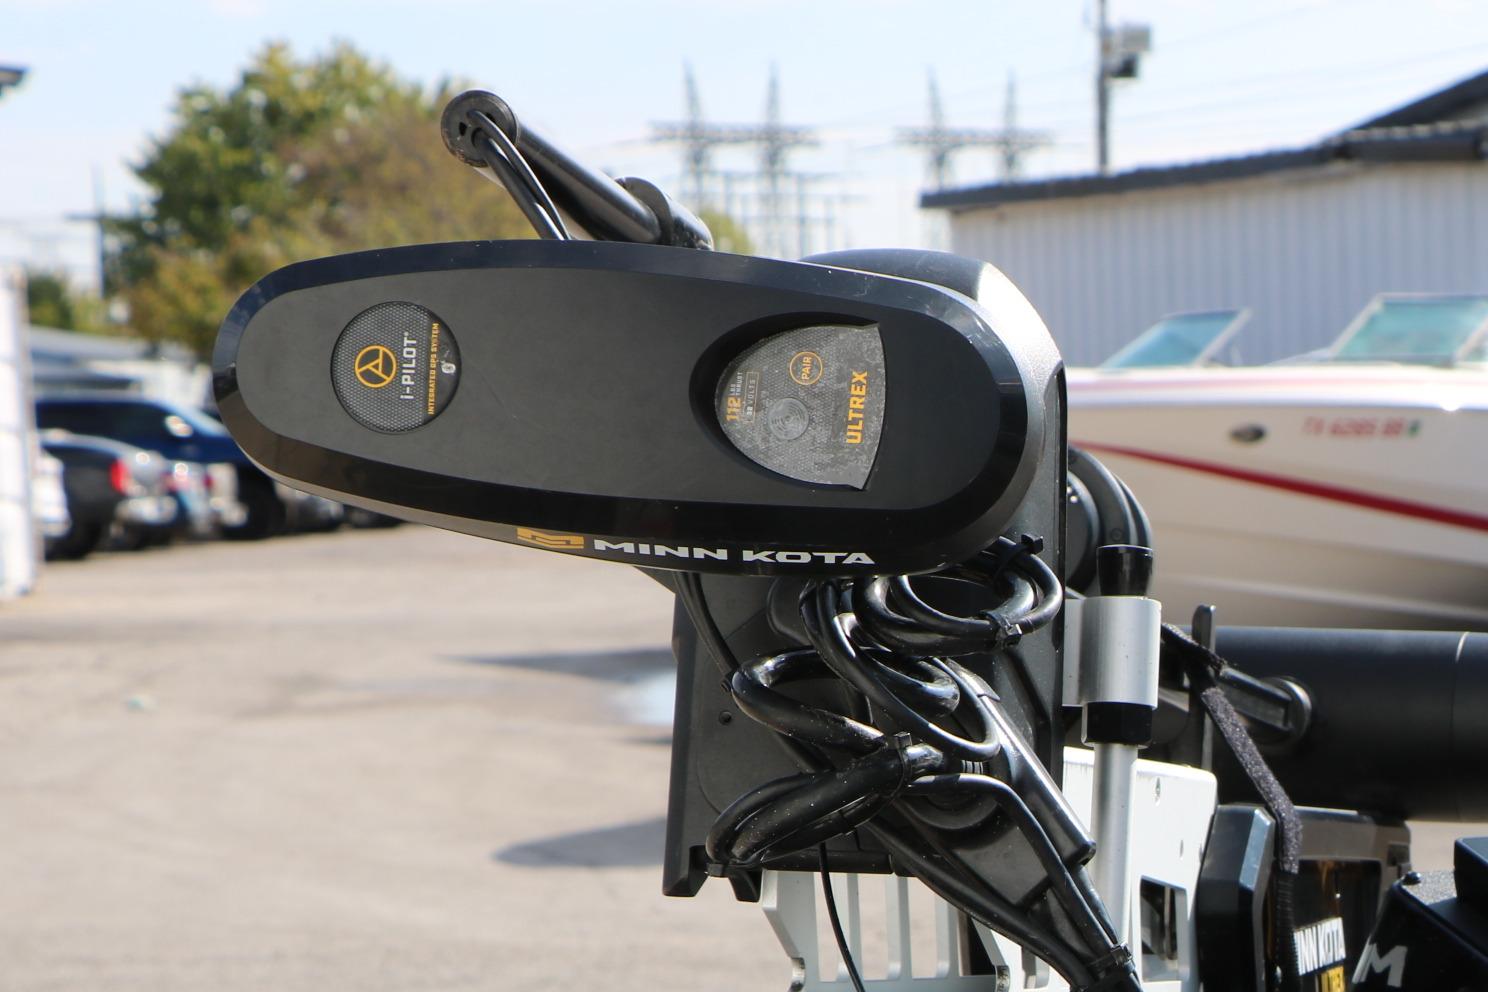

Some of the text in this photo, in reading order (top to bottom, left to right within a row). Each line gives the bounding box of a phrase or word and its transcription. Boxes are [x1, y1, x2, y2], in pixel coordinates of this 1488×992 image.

[801, 356, 813, 381] PAIR
[846, 370, 868, 444] ULTREX
[593, 538, 876, 566] MINN KOTA
